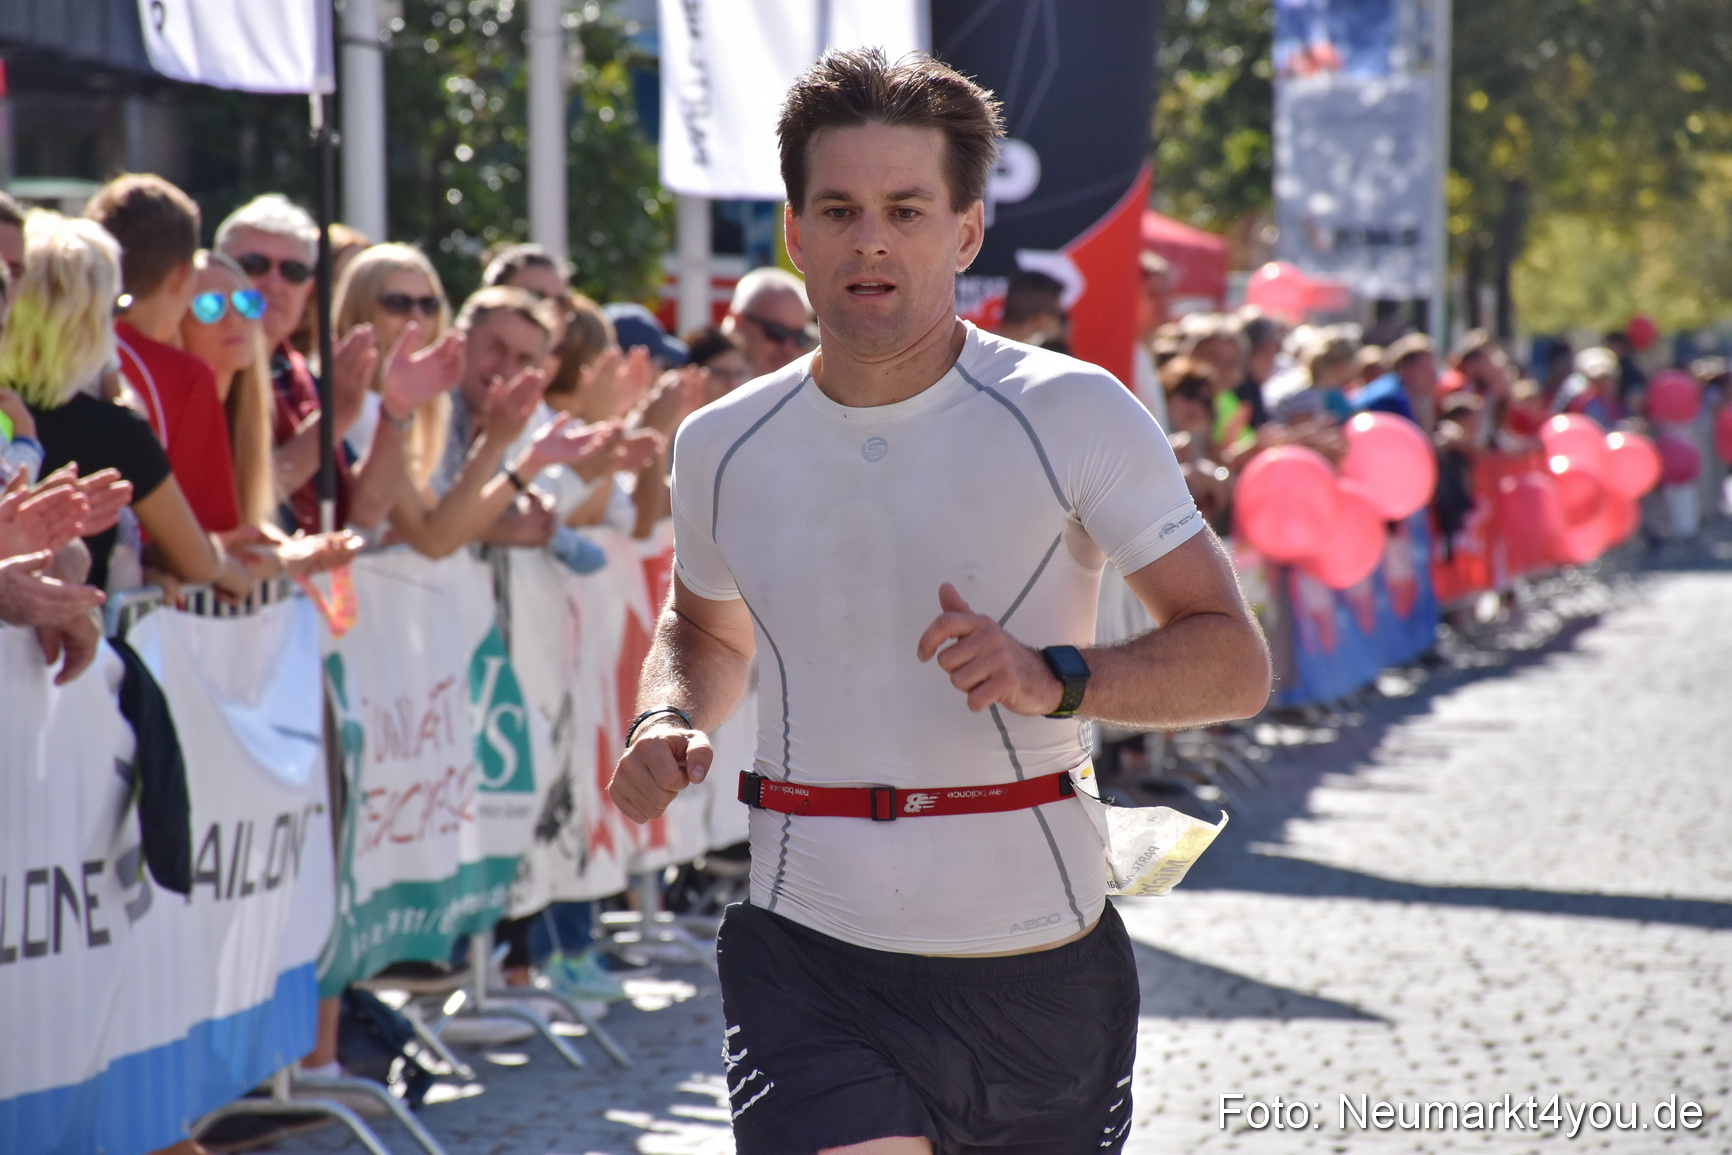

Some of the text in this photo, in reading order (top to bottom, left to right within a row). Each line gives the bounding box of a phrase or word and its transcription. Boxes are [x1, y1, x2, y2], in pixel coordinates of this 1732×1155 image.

[769, 784, 794, 796] balce
[946, 790, 987, 799] balance
[1009, 913, 1061, 934] A200
